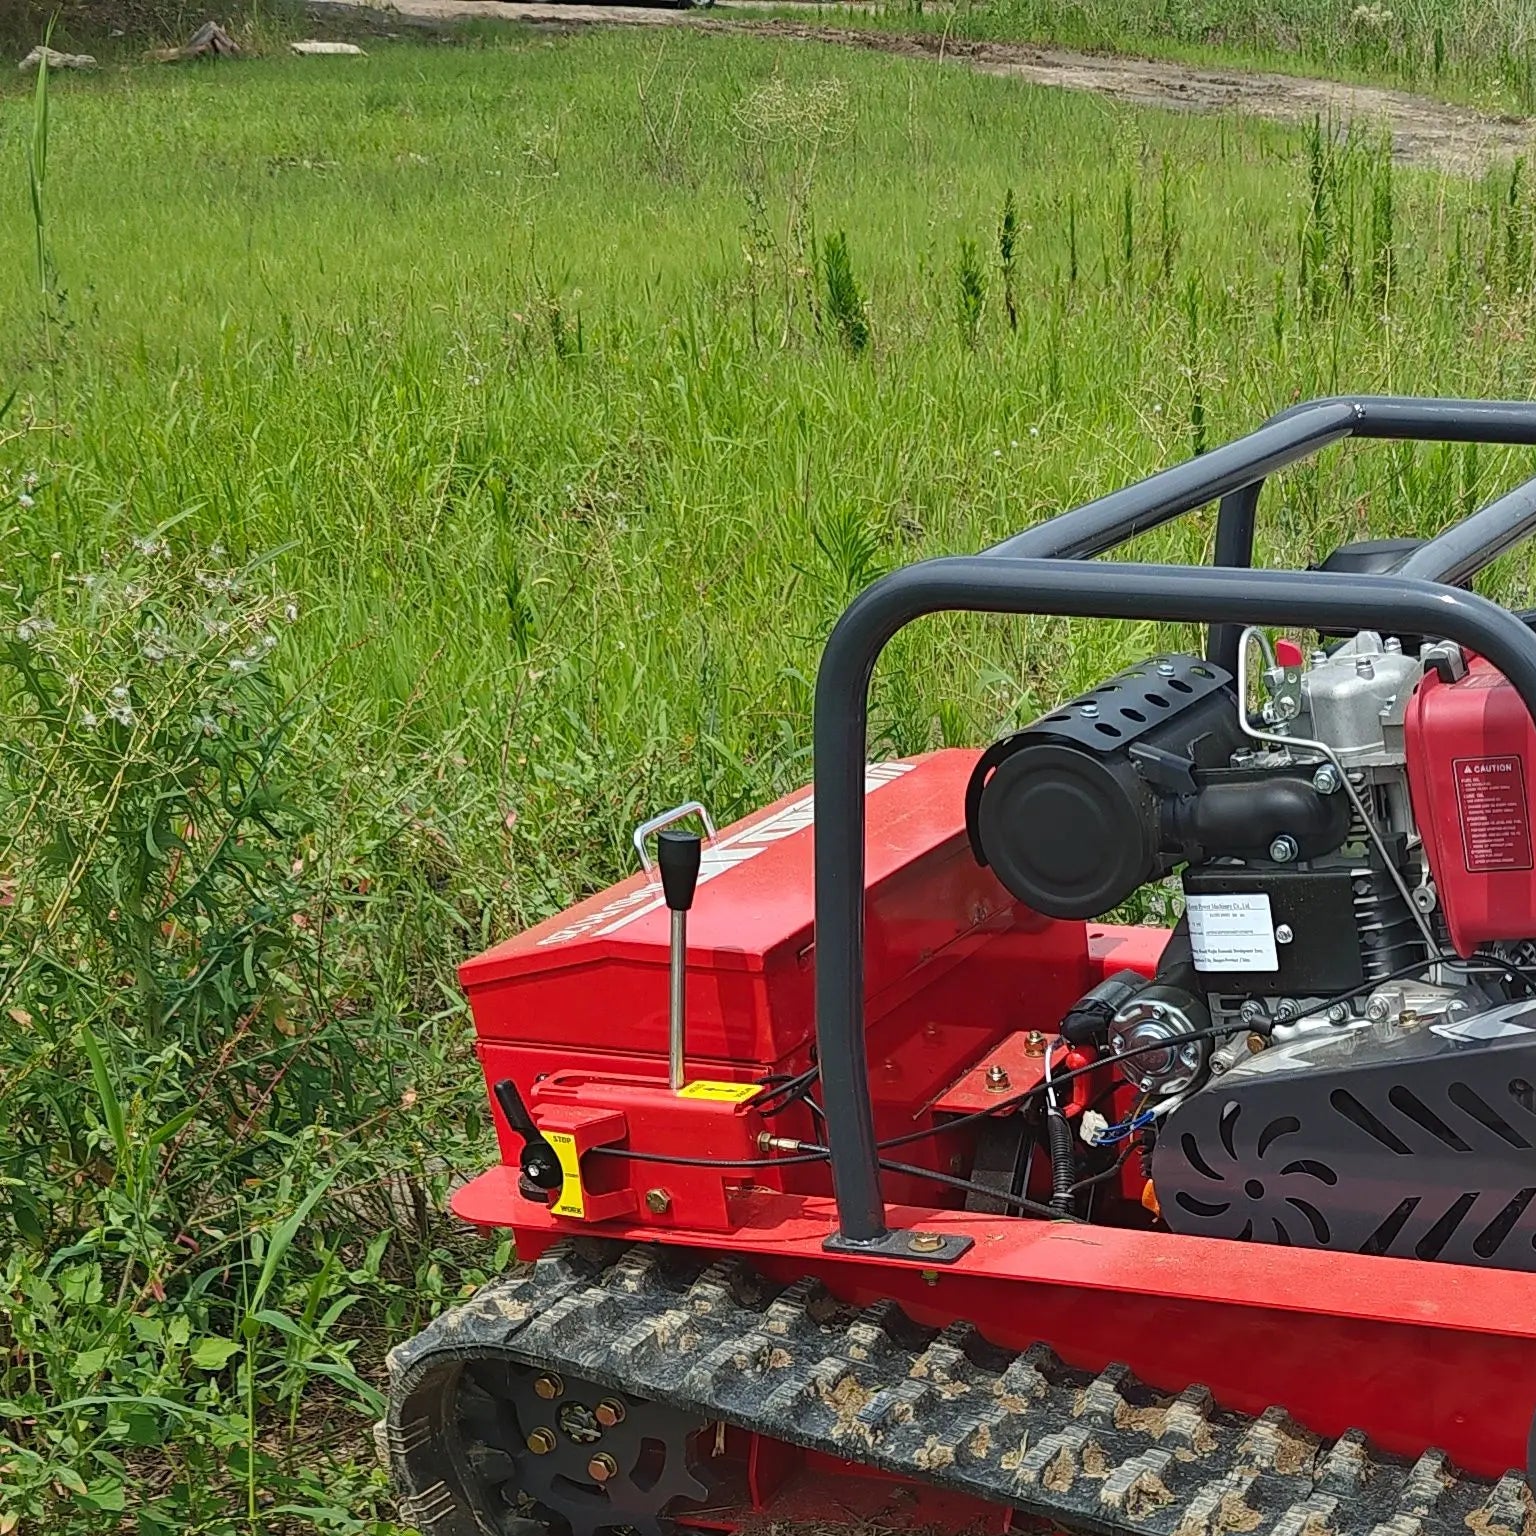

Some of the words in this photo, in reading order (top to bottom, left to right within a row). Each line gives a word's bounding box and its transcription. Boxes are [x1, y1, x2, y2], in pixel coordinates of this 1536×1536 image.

[1473, 763, 1512, 774] CAUTION
[553, 1135, 572, 1145] STOP
[561, 1205, 583, 1215] WORK
